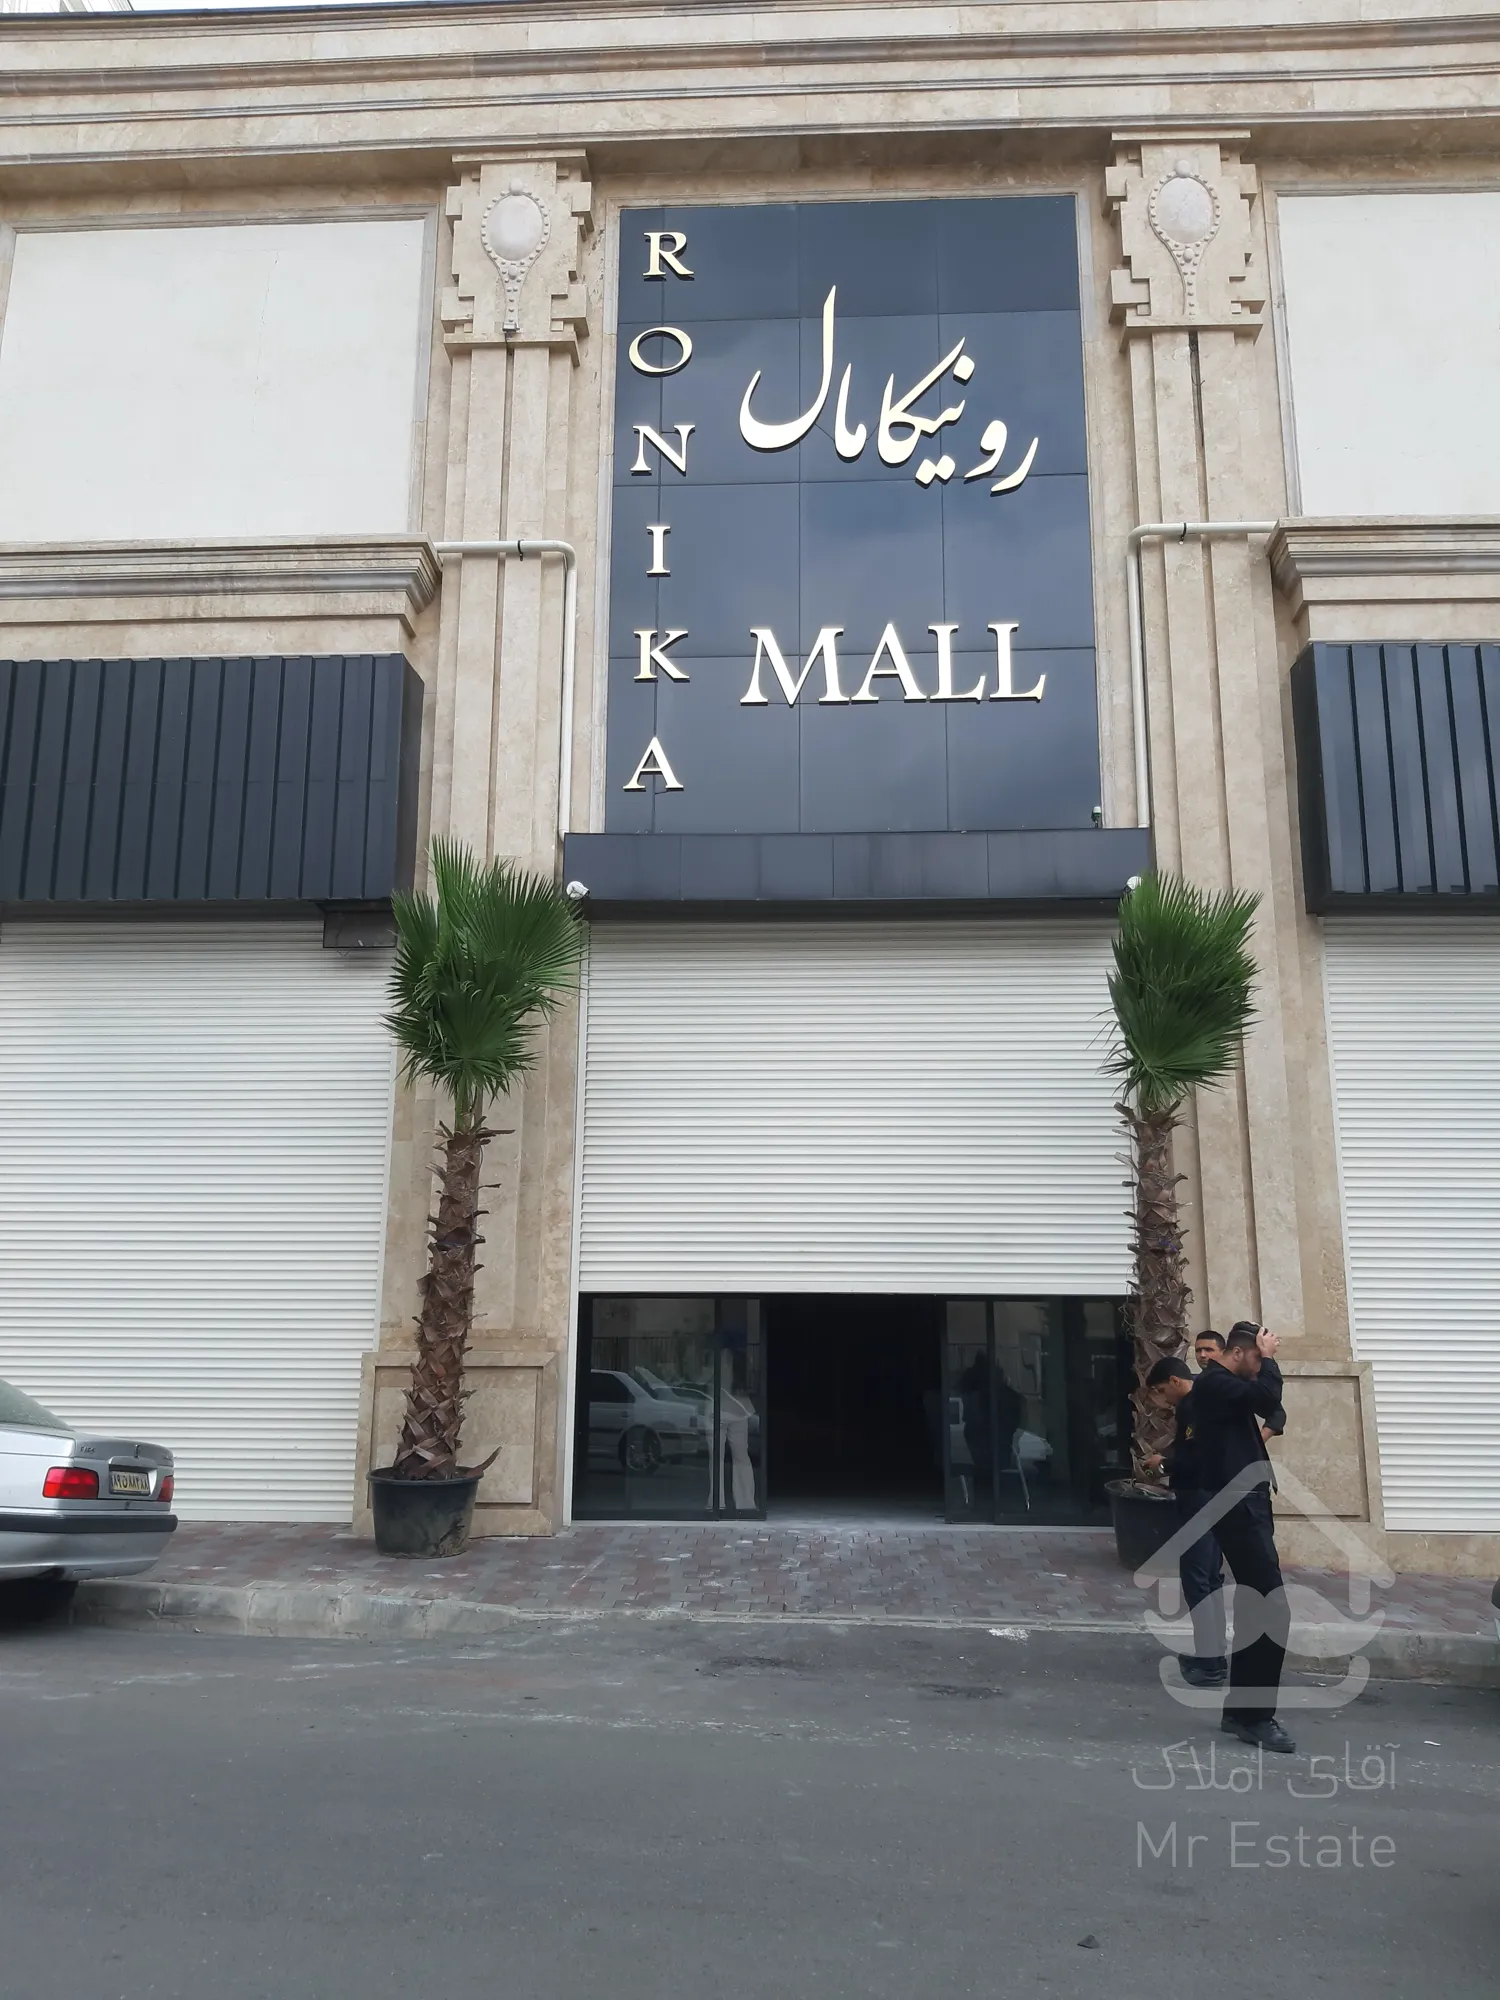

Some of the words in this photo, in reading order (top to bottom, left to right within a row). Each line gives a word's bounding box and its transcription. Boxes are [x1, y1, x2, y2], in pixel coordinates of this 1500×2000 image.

[739, 284, 867, 459] مال
[877, 336, 1040, 494] رونیکا
[622, 231, 695, 791] RONIKA
[740, 622, 1047, 705] MALL
